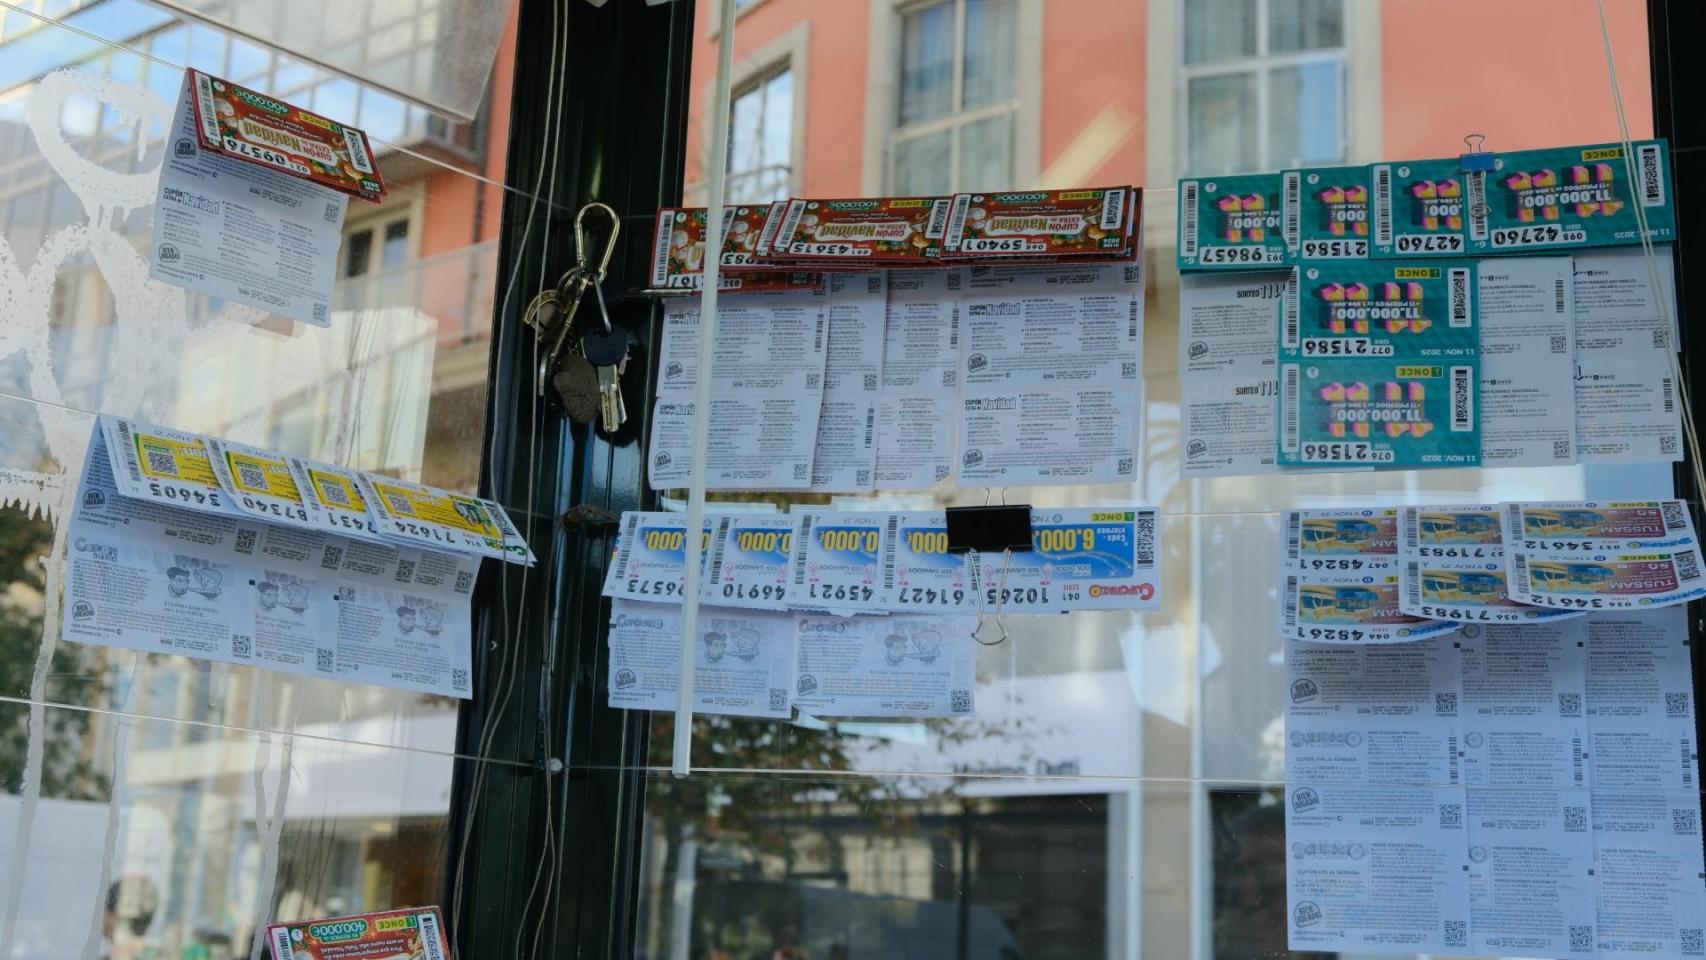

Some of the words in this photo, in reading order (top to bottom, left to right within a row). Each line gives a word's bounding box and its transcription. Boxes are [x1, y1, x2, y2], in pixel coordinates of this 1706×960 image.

[244, 123, 301, 151] Navidad
[226, 138, 286, 165] 09576
[1584, 151, 1617, 160] ONCE
[992, 193, 1048, 202] 400.000€
[821, 224, 875, 237] Navidad
[991, 218, 1047, 232] Navidad
[1049, 223, 1078, 231] CUPÓN
[1493, 227, 1560, 246] 42760
[1614, 230, 1635, 239] 2025
[791, 244, 849, 254] 43615
[966, 240, 1022, 250] 59401
[1305, 241, 1367, 257] 21586
[1398, 235, 1461, 253] 42760
[1202, 248, 1262, 263] 98657
[1397, 269, 1428, 277] ONCE
[1237, 289, 1260, 298] SORTEO
[1330, 307, 1419, 319] 11.000.000€
[1305, 340, 1367, 355] 21586
[1399, 368, 1430, 376] ONCE
[1235, 386, 1259, 395] SORTEO
[1330, 409, 1421, 422] 11.000.000€
[1304, 444, 1367, 460] 21586
[1371, 452, 1391, 460] 076
[149, 483, 221, 507] 34605
[1092, 513, 1123, 521] ONCE
[394, 522, 456, 544] 71624
[1600, 525, 1661, 534] TUSSAM
[1419, 546, 1486, 559] 71983
[1524, 541, 1593, 551] 34612
[1299, 559, 1364, 570] 48261
[1609, 580, 1674, 589] TUSSAM
[723, 584, 785, 600] 46910
[809, 584, 873, 601] 45921
[898, 588, 964, 605] 61427
[987, 587, 1049, 604] 10265
[1062, 592, 1080, 600] 041
[1531, 594, 1603, 609] 34612
[1421, 606, 1490, 622] 71983
[1298, 626, 1364, 640] 48261
[312, 923, 365, 936] 400.000€
